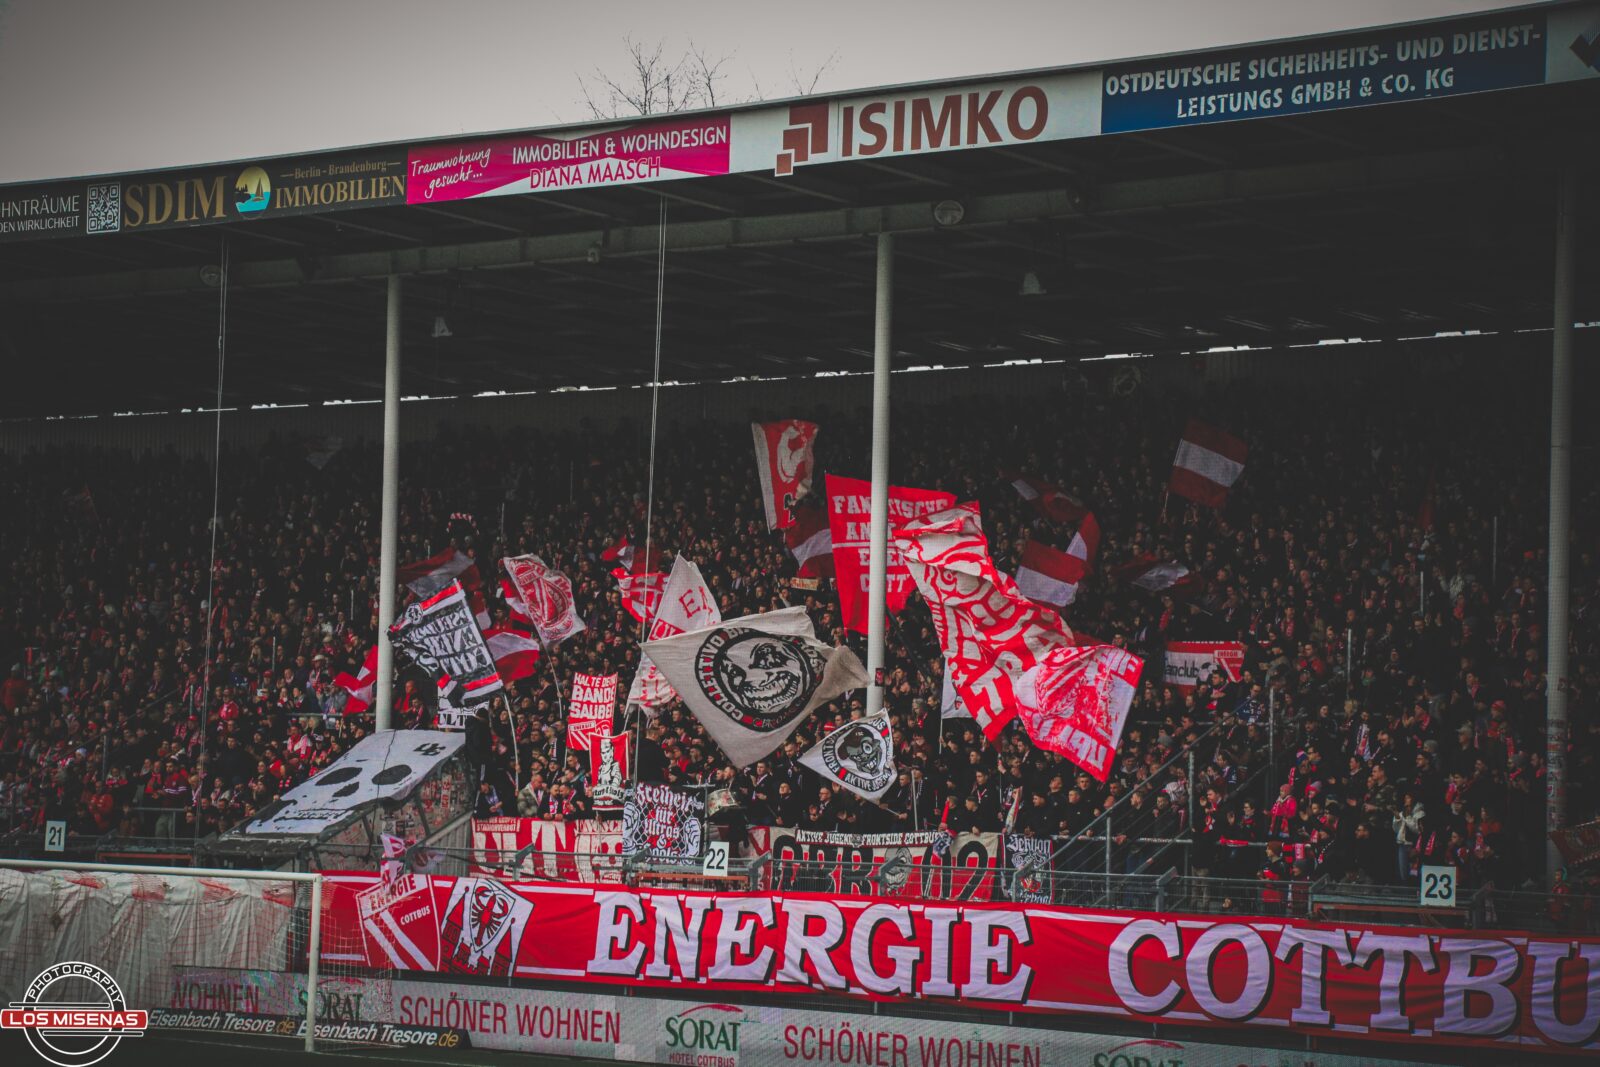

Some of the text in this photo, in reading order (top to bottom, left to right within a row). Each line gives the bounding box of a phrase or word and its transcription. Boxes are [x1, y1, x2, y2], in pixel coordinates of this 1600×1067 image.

[1105, 23, 1542, 97] OSTDEUTSCHE SICHERHEITS- UND DIENST-
[1176, 67, 1456, 119] LEISTUNGS GMBH & CO. KG
[841, 84, 1049, 158] ISIMKO
[410, 147, 492, 178] Traumwohnung
[511, 124, 727, 166] IMMOBILIEN & WOHNDESIGN
[529, 155, 661, 190] DIANA MAASCH
[124, 174, 228, 228] SDIM
[275, 174, 407, 209] IMMOBILIEN
[17, 215, 80, 231] WIRKLICHKEIT
[569, 701, 613, 719] SAUBE
[49, 826, 62, 847] 21
[706, 848, 726, 870] 22
[1425, 873, 1453, 900] 23
[400, 905, 431, 925] COTTBUS
[586, 891, 1034, 1002] ENERGIE
[149, 1008, 295, 1035] Eisenbach Tresore.de
[297, 1020, 459, 1047] Esenbach Tresore.de
[400, 992, 621, 1044] SCHÖNER WOHNEN
[665, 1016, 741, 1052] SORAT
[669, 1052, 735, 1067] HOTEL COTTBUS
[784, 1021, 908, 1067] SCHÖNER
